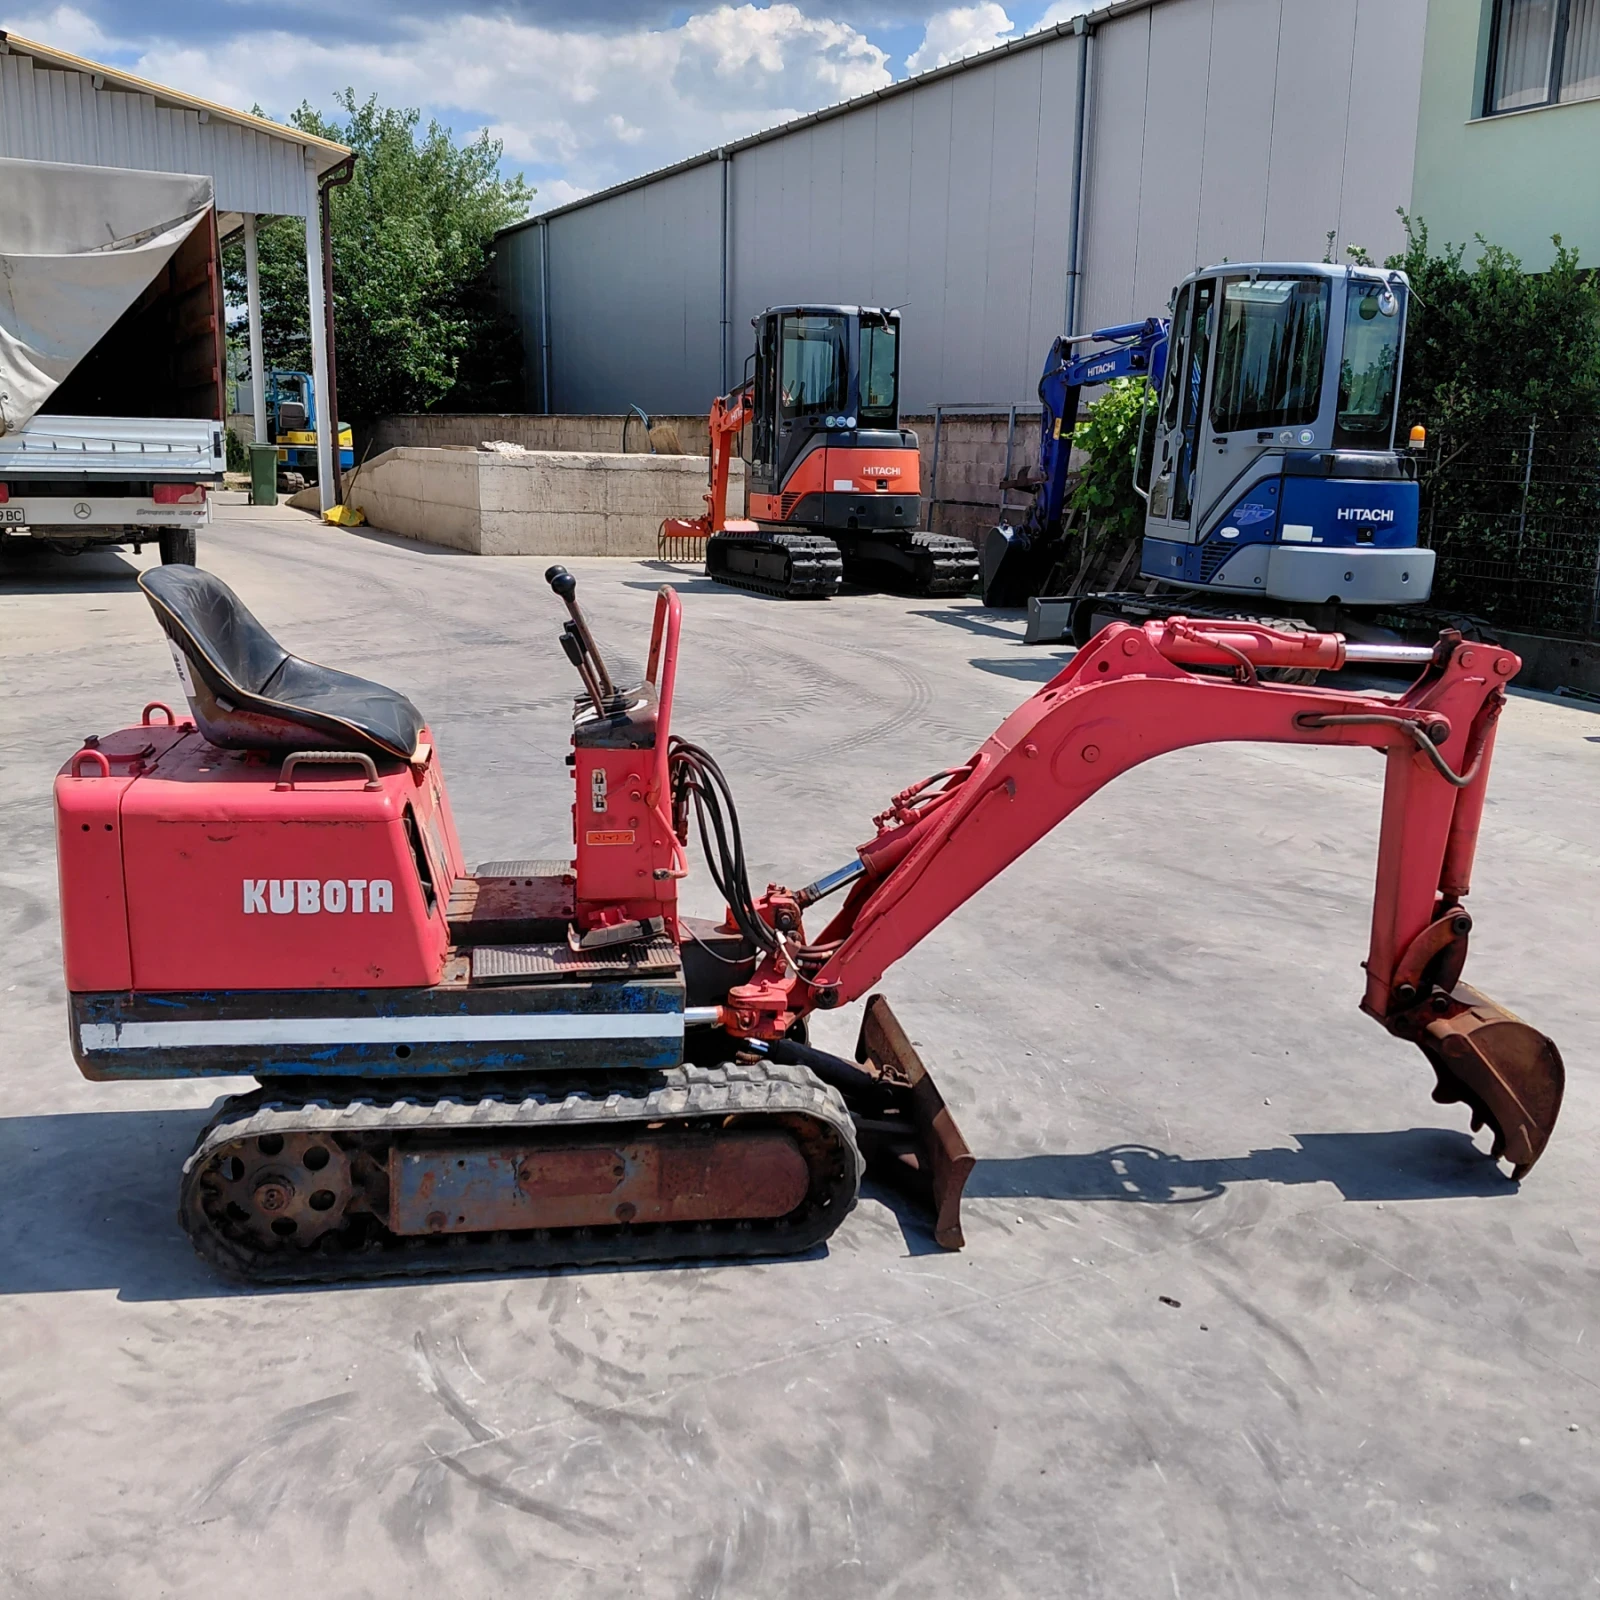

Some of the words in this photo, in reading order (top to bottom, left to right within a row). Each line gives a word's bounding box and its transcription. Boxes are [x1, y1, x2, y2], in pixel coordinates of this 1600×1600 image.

[1087, 361, 1116, 377] HITACHI
[863, 466, 901, 475] HITACHI
[6, 510, 22, 522] BC
[1337, 508, 1394, 522] HITACHI
[243, 879, 394, 914] KUBOTA
